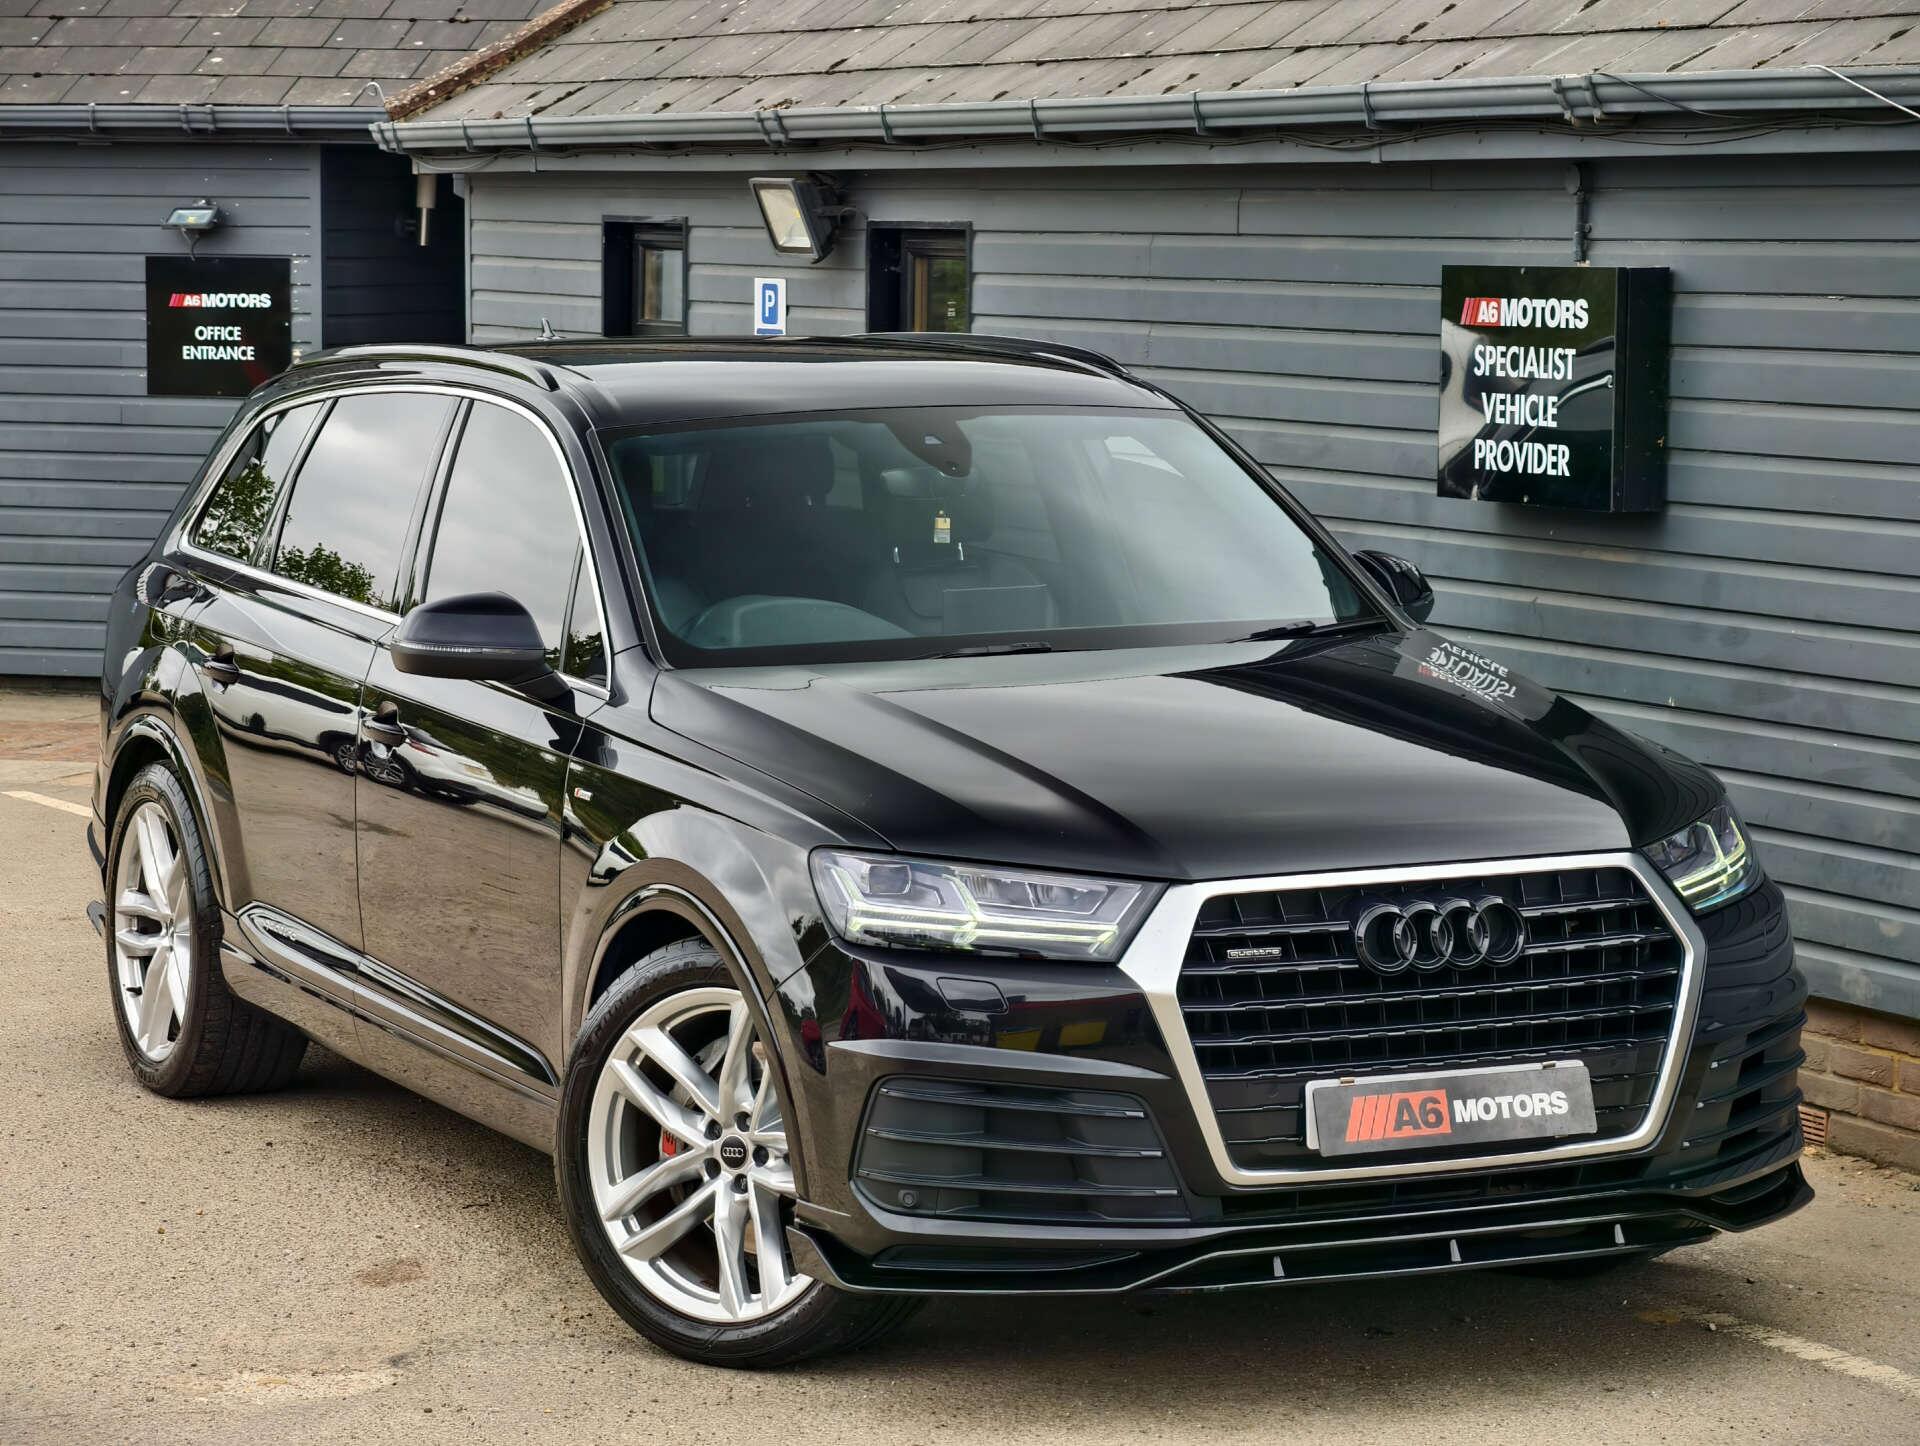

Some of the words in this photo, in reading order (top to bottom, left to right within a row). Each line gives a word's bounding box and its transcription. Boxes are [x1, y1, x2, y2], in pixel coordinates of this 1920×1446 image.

[765, 289, 776, 318] P
[194, 326, 242, 341] OFFICE
[182, 345, 255, 360] ENTRANCE
[1473, 344, 1576, 380] SPECIALIST
[1481, 392, 1558, 427] VEHICLE
[1474, 438, 1571, 477] PROVIDER
[1392, 1096, 1444, 1132] A6
[1453, 1090, 1569, 1123] MOTORS
